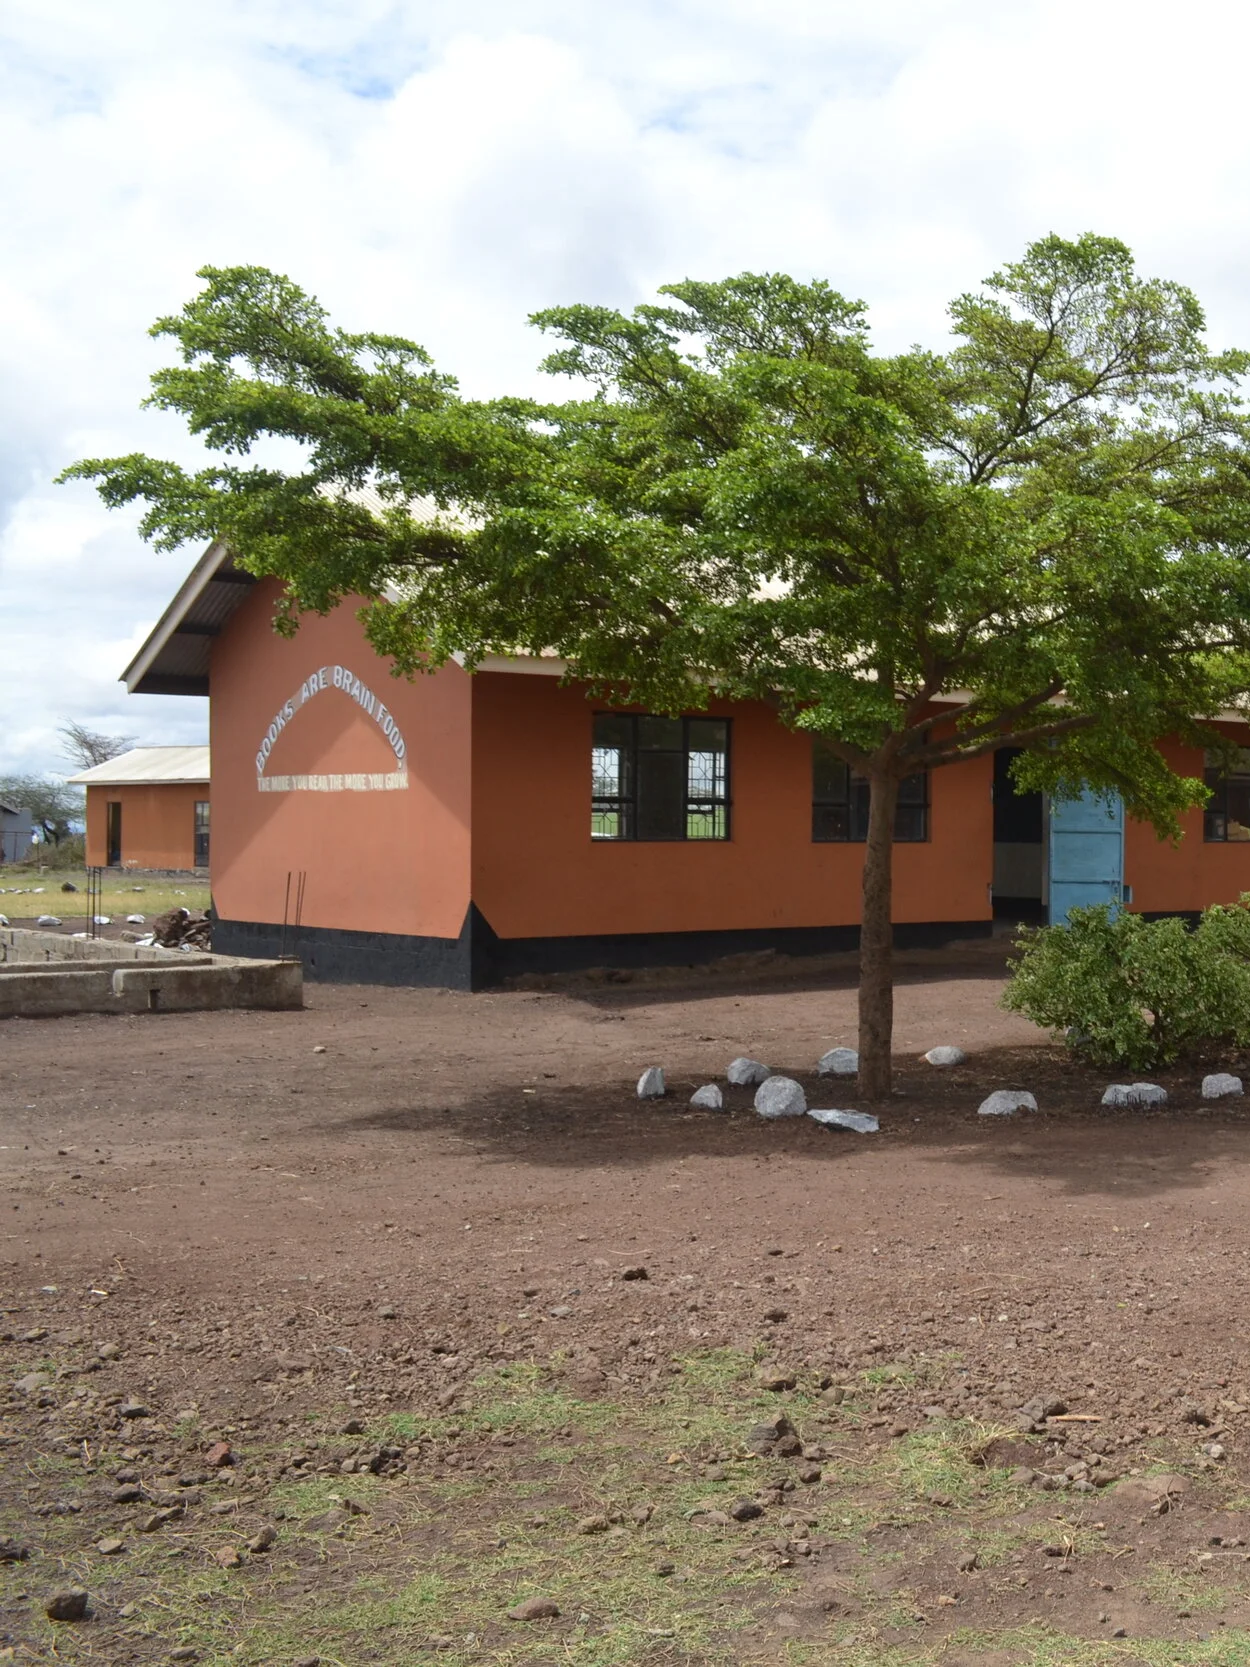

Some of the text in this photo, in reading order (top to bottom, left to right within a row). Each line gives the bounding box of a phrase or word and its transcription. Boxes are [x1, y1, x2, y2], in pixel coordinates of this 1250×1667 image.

[256, 699, 294, 774] BOOKS
[301, 666, 328, 703] ARE
[333, 665, 375, 715] BRAIN
[257, 777, 270, 792] THE
[291, 774, 308, 791] YOU
[328, 774, 344, 792] THE
[344, 773, 367, 792] MORE
[367, 773, 384, 791] YOU
